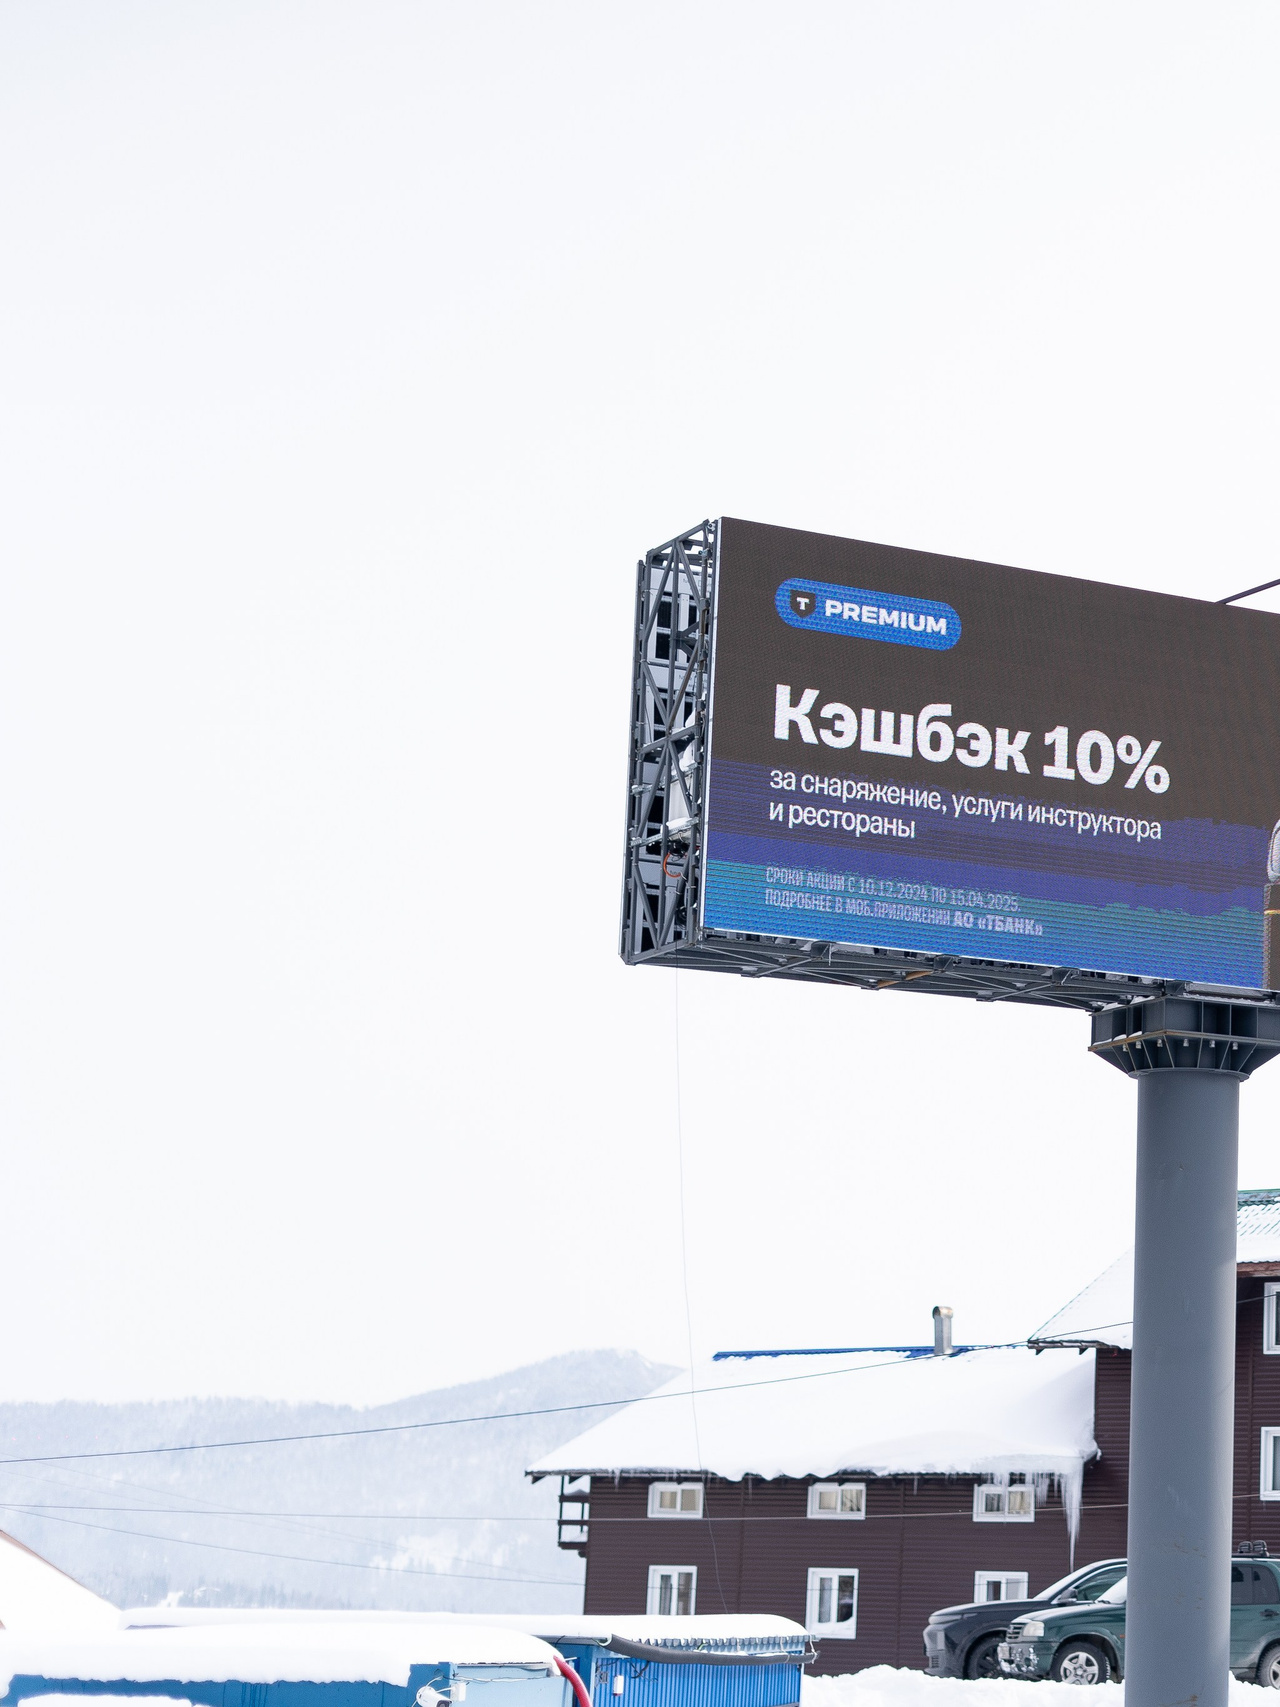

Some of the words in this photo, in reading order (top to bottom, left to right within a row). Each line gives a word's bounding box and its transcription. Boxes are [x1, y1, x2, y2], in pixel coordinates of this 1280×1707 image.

[825, 599, 948, 636] PREMIUM
[774, 684, 1032, 775] Кэшбэк
[1042, 725, 1171, 794] 10%
[769, 768, 796, 791] за
[801, 772, 948, 814] снаряжение,
[951, 793, 1024, 824] услуги
[1028, 806, 1162, 841] инструктора
[769, 802, 784, 822] и
[788, 803, 916, 839] рестораны
[766, 866, 804, 887] СРОКИ
[807, 872, 845, 892] АКЦИИ
[848, 877, 856, 893] С
[859, 879, 929, 901] 10.12.2024
[932, 887, 947, 904] ПО
[765, 888, 833, 912] ПОДРОБНЕЕ
[835, 897, 843, 913] В
[953, 911, 974, 929] АО
